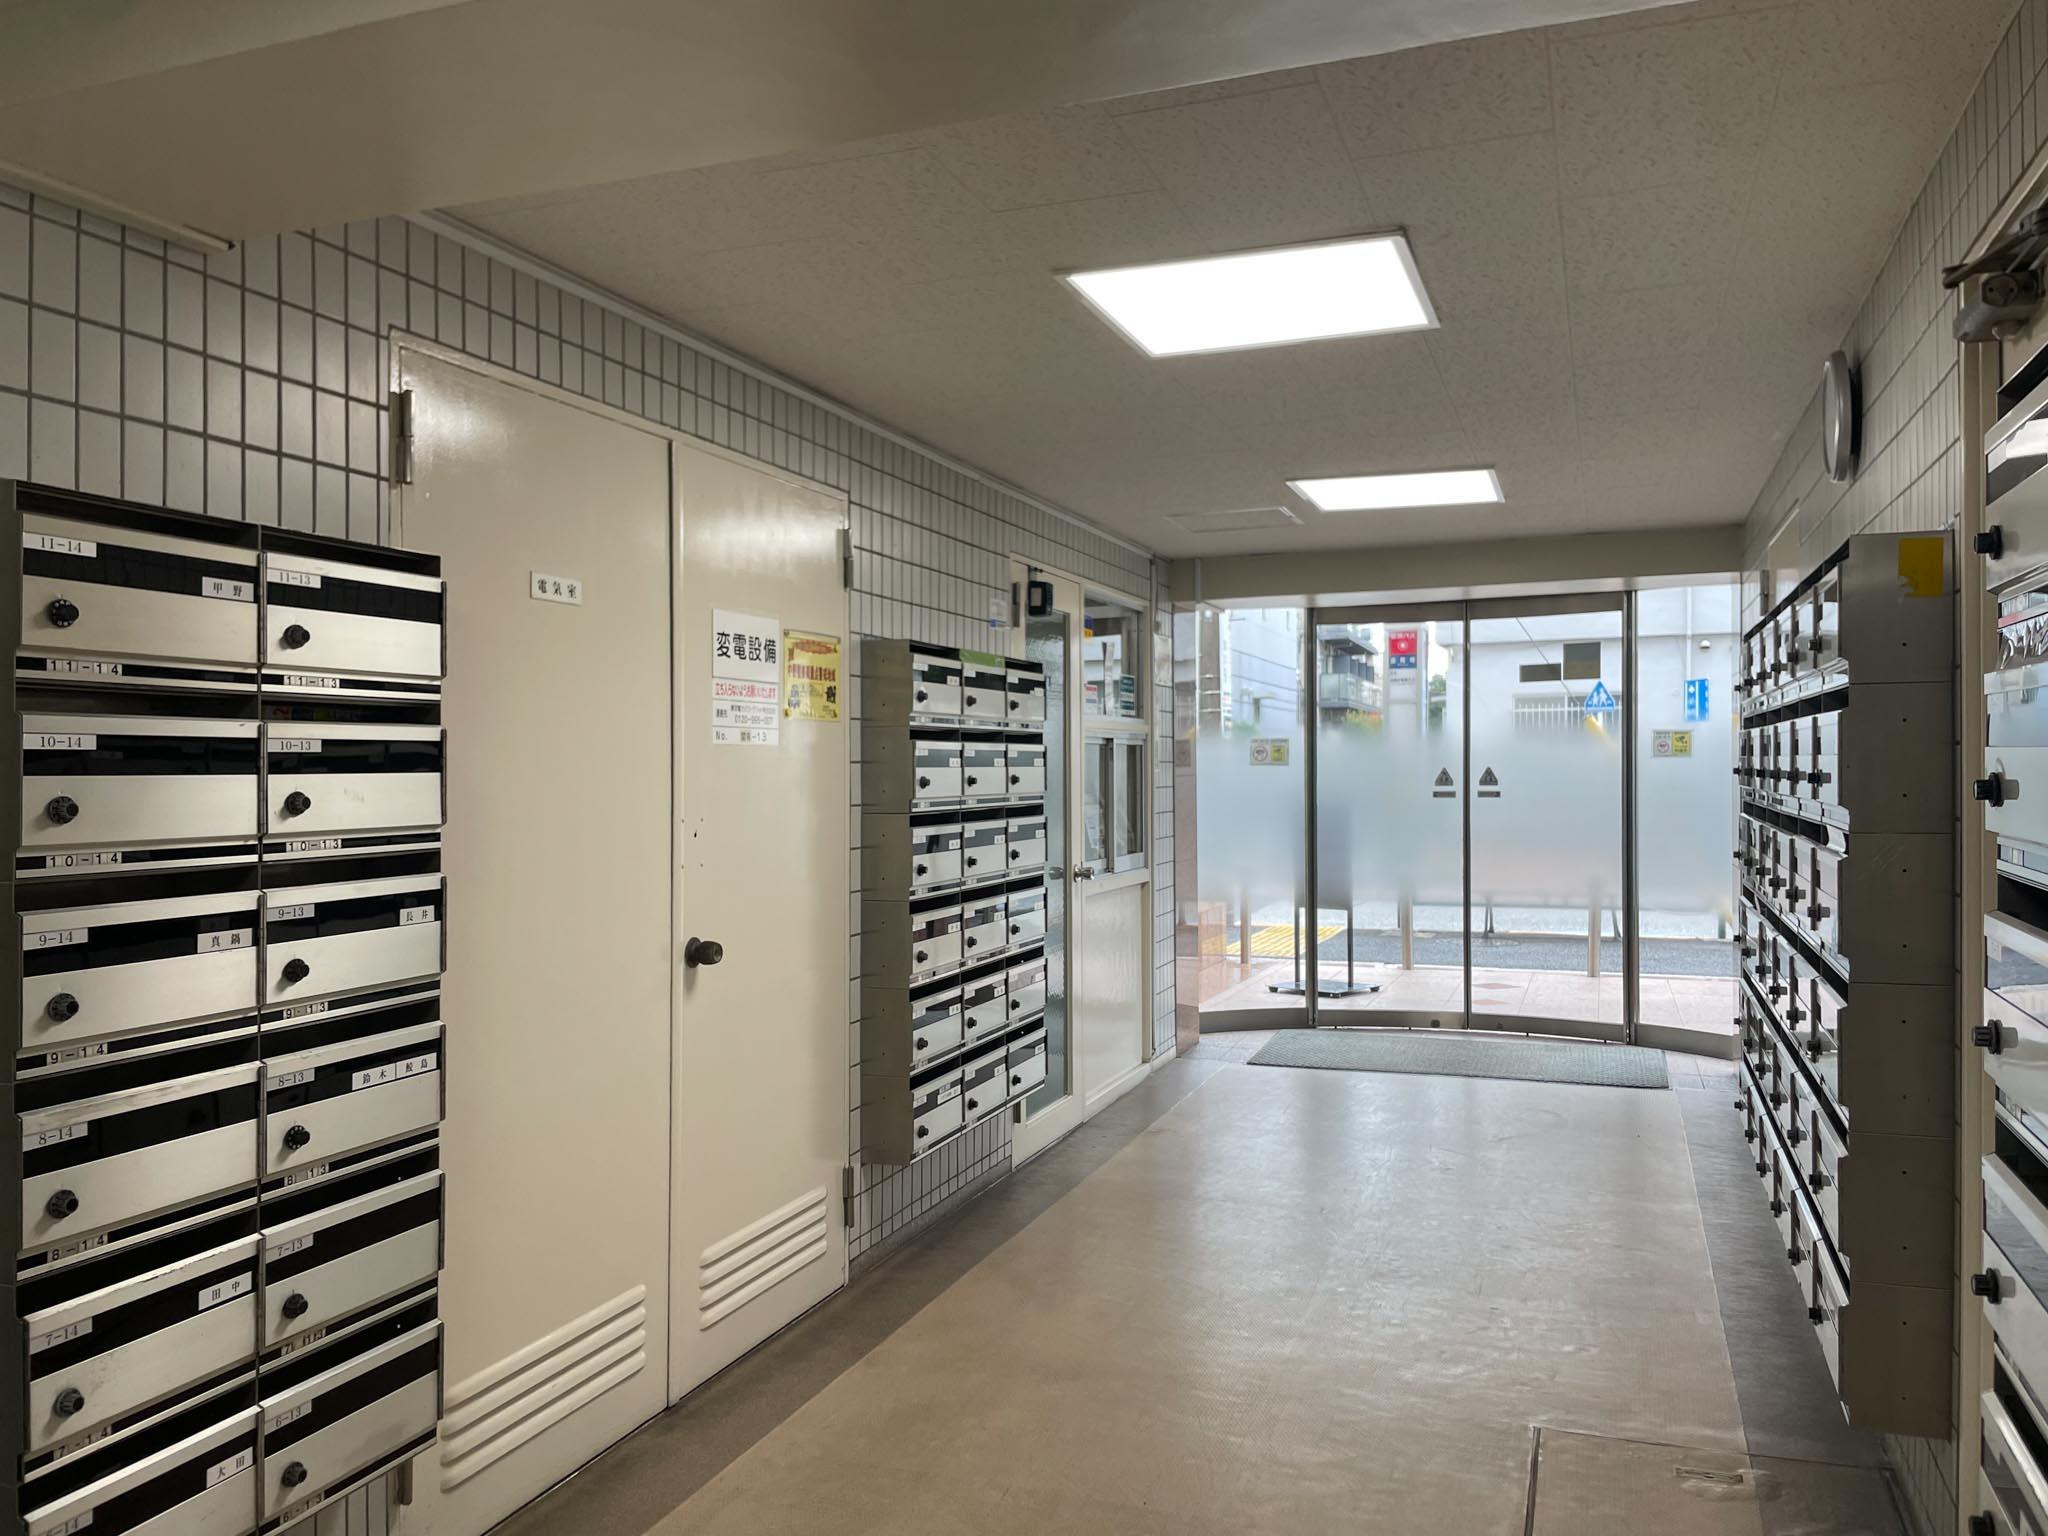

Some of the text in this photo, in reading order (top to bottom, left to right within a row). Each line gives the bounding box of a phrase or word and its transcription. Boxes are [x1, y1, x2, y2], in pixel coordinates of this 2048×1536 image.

[39, 537, 83, 553] 11-14
[279, 570, 312, 586] 11-13
[537, 577, 577, 600] 電気室
[716, 631, 777, 665] 変電設備
[50, 659, 120, 676] 11-14
[286, 674, 339, 689] 11-13
[39, 734, 84, 749] 10-14
[280, 741, 311, 752] 10-13
[287, 839, 341, 851] 10-13
[50, 852, 120, 868] 10-14
[278, 905, 305, 919] 9-13
[406, 909, 429, 922] 長井
[39, 931, 74, 946] 9-14
[211, 932, 241, 948] 真鍋
[50, 1043, 105, 1064] 9-14
[278, 1071, 305, 1086] 8-13
[362, 1068, 387, 1085] 鈴木
[39, 1127, 74, 1146] 8-14
[51, 1235, 106, 1261] 8-14
[277, 1236, 305, 1255] 7-13
[212, 1280, 241, 1301] 田中
[46, 1325, 79, 1346] 7-14
[275, 1404, 302, 1427] 6-13
[217, 1455, 245, 1479] 大田
[46, 1518, 79, 1536] -14
